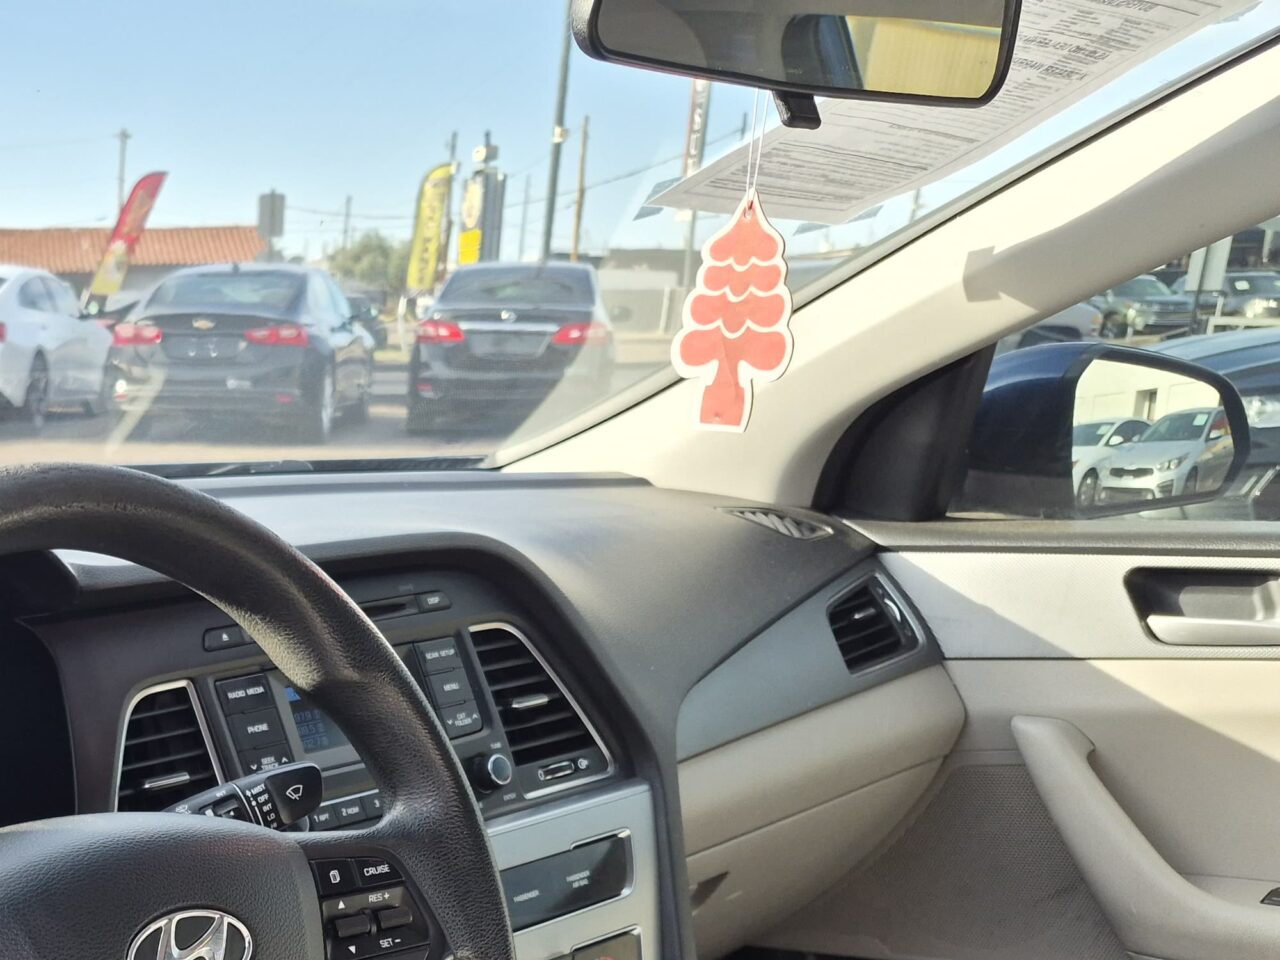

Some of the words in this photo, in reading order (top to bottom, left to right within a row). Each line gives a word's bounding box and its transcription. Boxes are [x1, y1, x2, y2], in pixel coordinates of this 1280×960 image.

[227, 690, 246, 700] RADIO
[246, 686, 265, 696] MEDIA
[247, 723, 269, 735] PHONE
[250, 783, 266, 795] MIST
[257, 793, 269, 803] OFF
[364, 864, 391, 877] CRUISE
[368, 892, 383, 903] RES
[379, 938, 394, 948] SET
